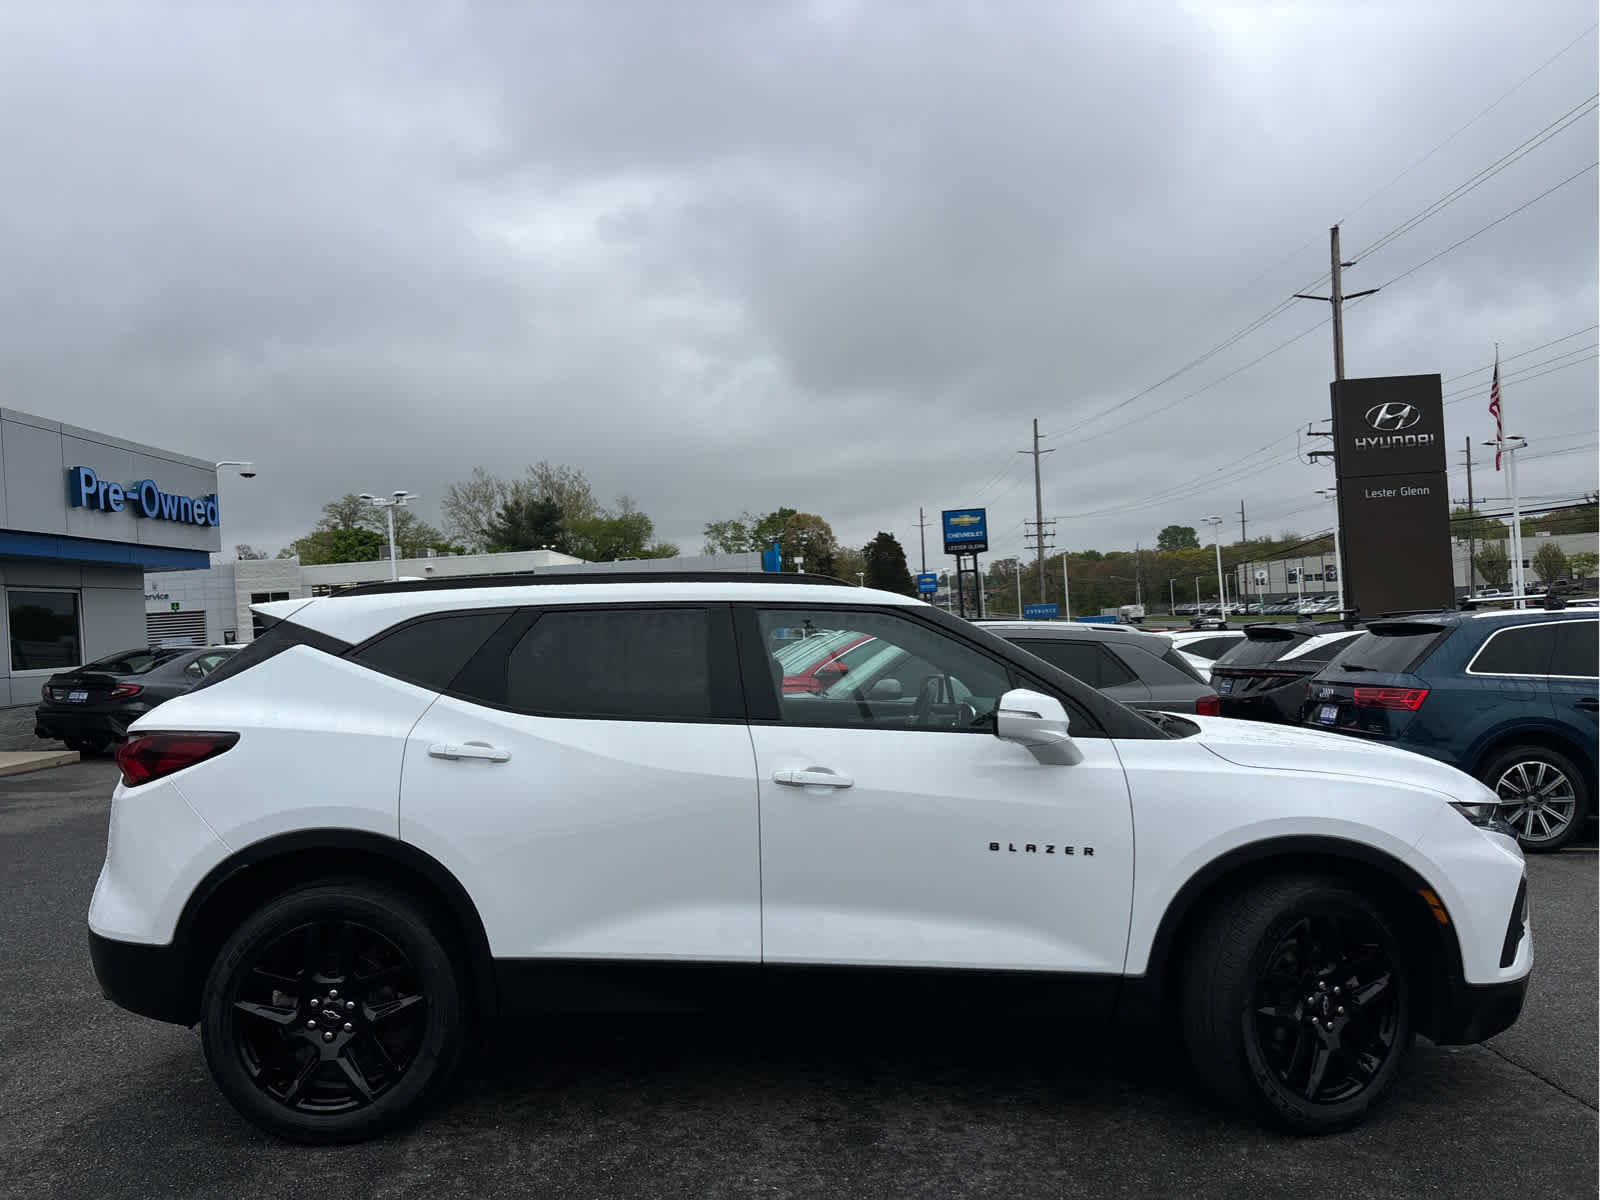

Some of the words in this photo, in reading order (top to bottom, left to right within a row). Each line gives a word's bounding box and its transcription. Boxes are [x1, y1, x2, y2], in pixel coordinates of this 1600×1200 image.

[1354, 433, 1435, 450] HYUNDAI
[72, 466, 219, 527] Pre-Owned
[1365, 487, 1397, 499] Lester
[1400, 486, 1430, 497] Glenn
[946, 530, 983, 539] CHEVROLET
[144, 591, 169, 601] ervice
[989, 842, 1095, 856] BLAZER
